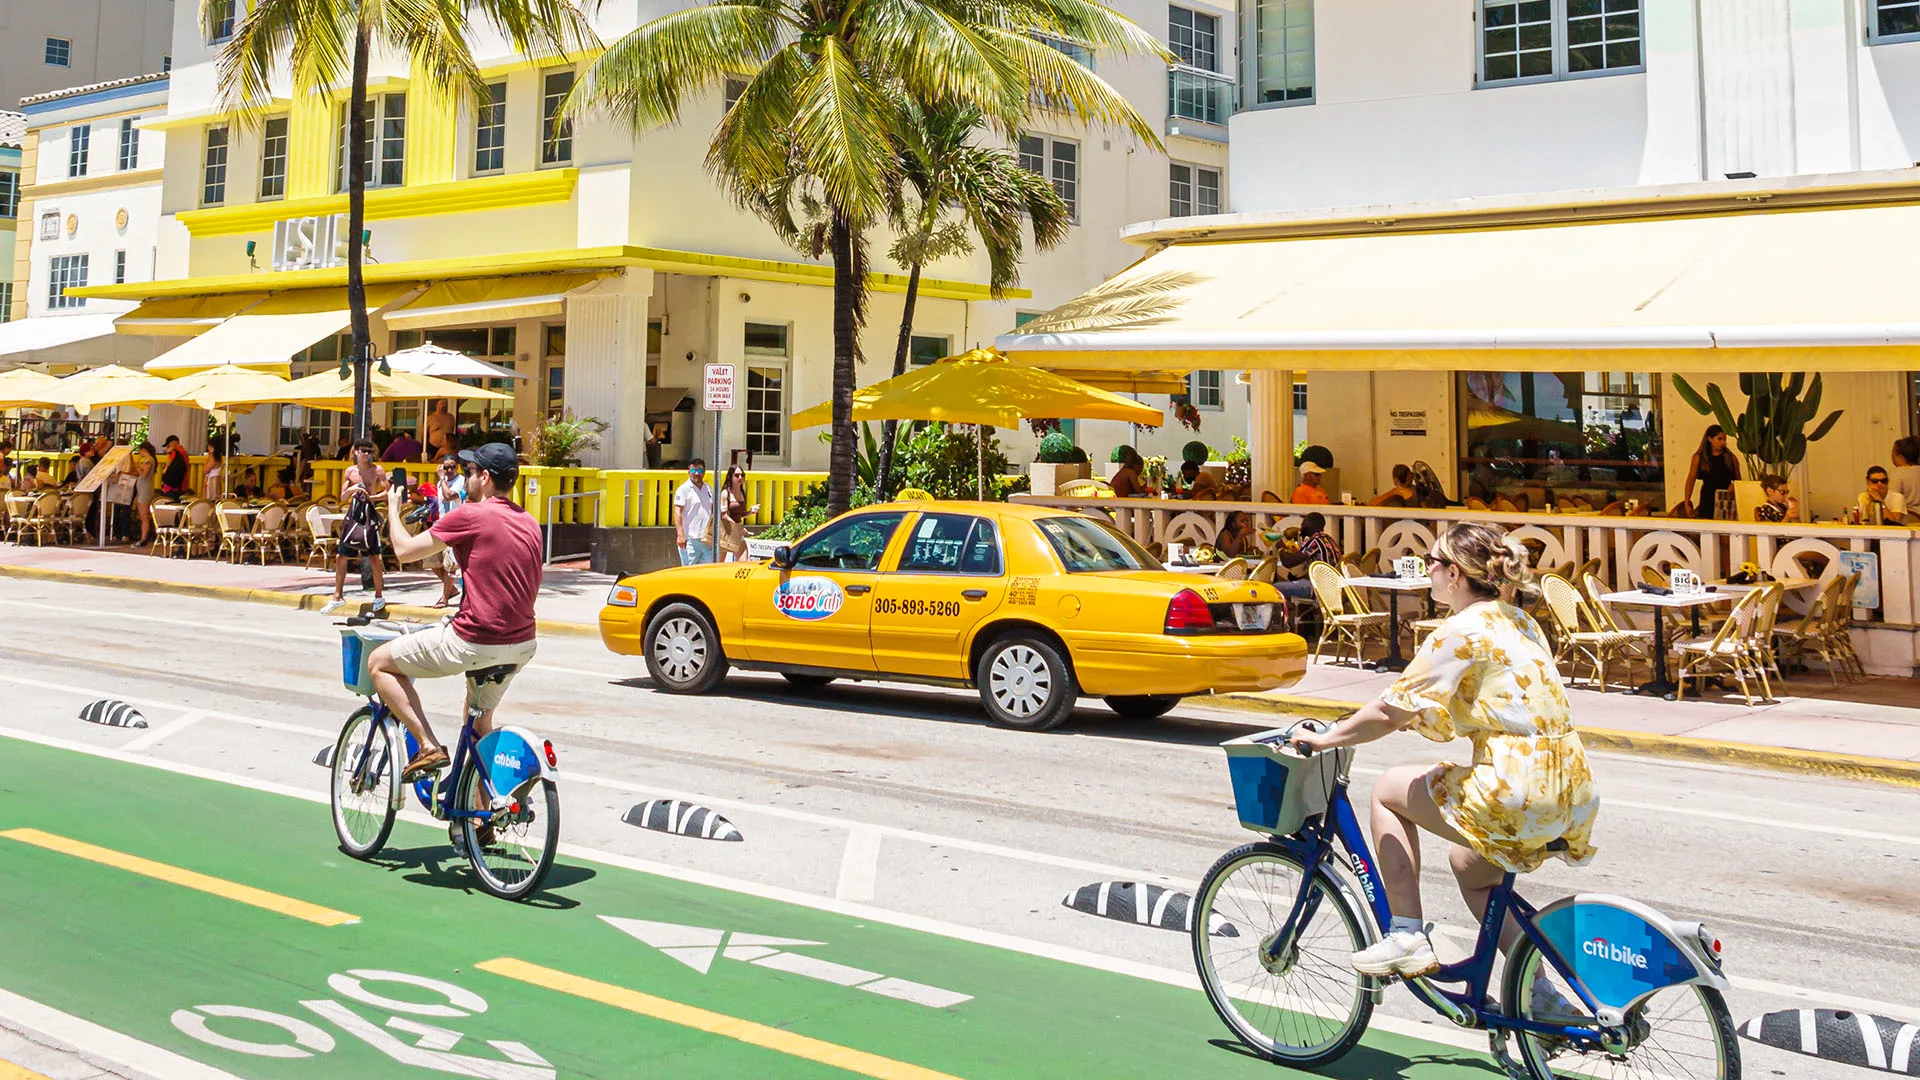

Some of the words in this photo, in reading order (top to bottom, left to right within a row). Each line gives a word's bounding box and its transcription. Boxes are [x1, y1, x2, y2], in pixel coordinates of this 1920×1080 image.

[707, 377, 732, 385] PARKING
[735, 567, 751, 580] 853
[1674, 576, 1690, 584] BIG
[778, 594, 816, 610] SOFLO
[815, 588, 840, 611] Cab
[1204, 587, 1219, 601] 853
[874, 598, 961, 617] 305-893-5260
[505, 754, 521, 769] bike
[1351, 853, 1367, 875] citi
[1360, 873, 1376, 903] bike
[1582, 938, 1609, 960] citi
[1611, 943, 1649, 970] bike
